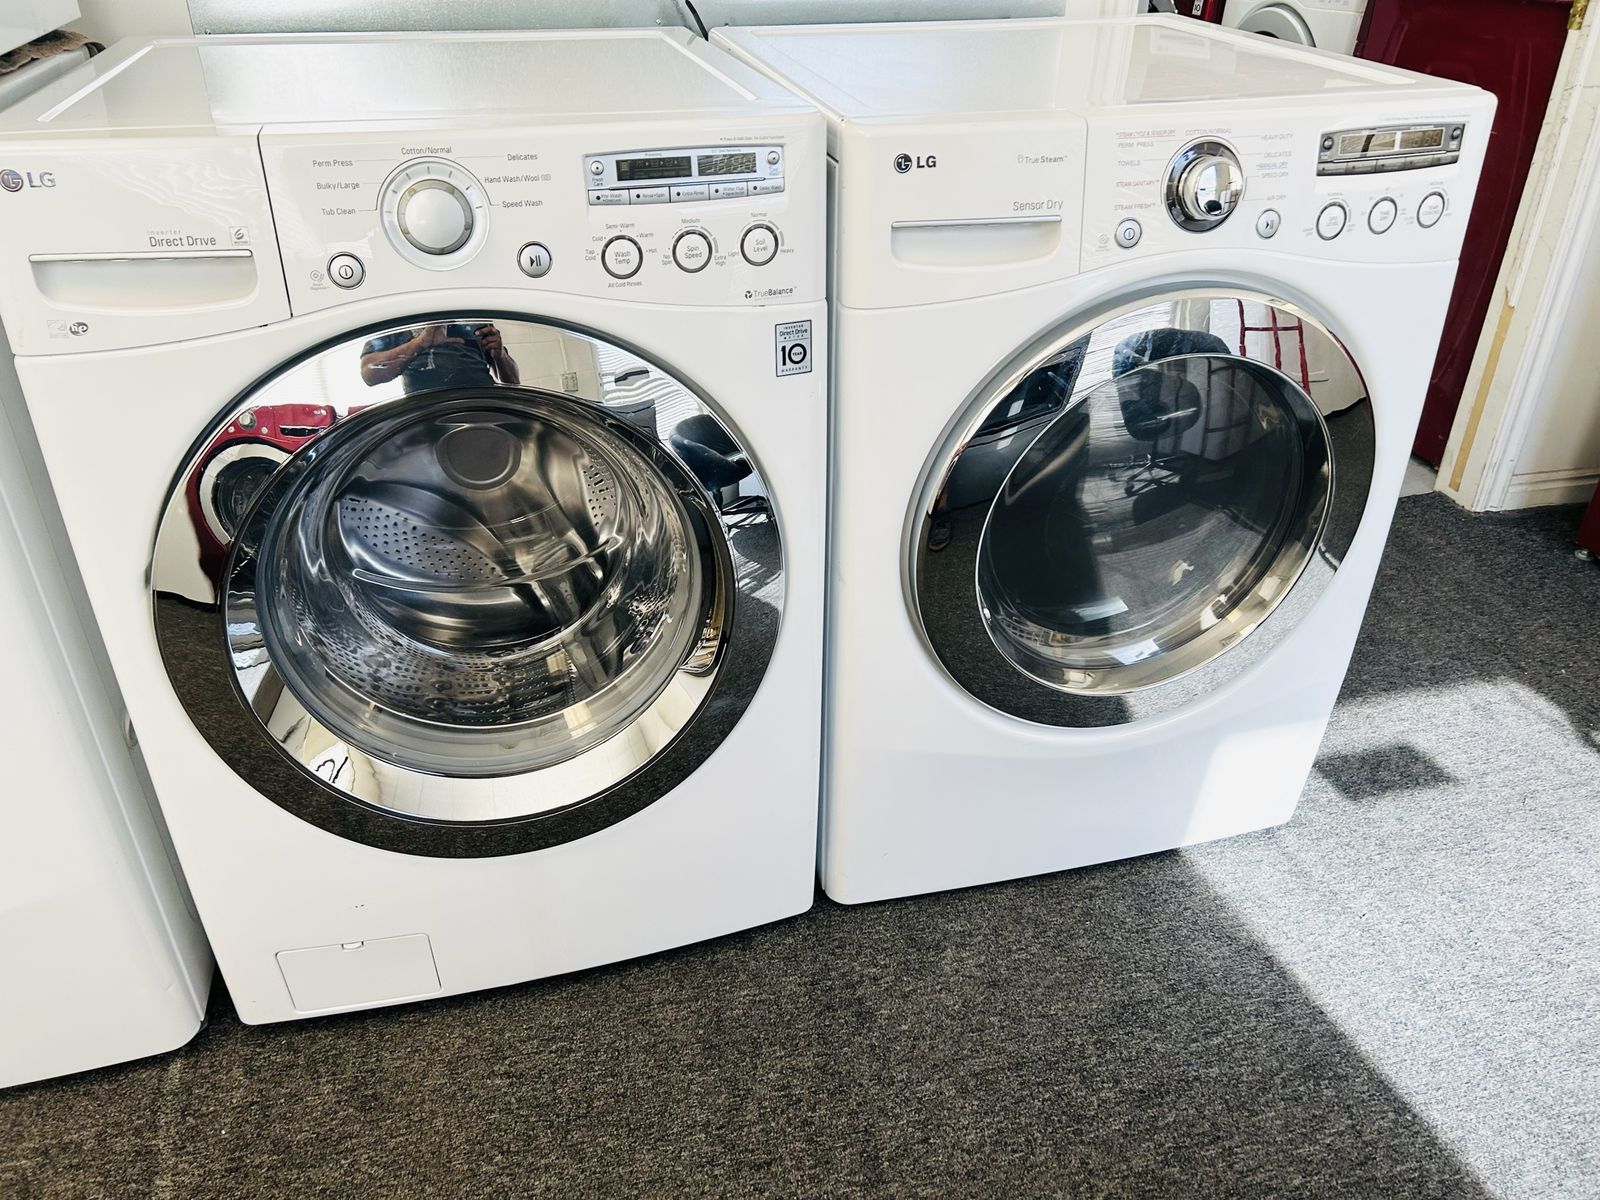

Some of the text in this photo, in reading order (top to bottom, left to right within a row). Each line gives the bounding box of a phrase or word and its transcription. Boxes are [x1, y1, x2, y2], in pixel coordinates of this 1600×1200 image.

[401, 146, 452, 155] Cotton/Normal
[507, 153, 538, 161] Delicates
[312, 159, 353, 168] Perm Press
[916, 156, 937, 168] LG
[26, 171, 57, 188] LG
[484, 174, 540, 184] Hand Wash/Wool
[316, 181, 360, 190] Bulky/Large
[502, 199, 543, 208] Speed Wash
[1012, 199, 1064, 212] Sensor Dry
[321, 207, 356, 216] Tub Clean
[149, 235, 216, 247] Direct Drive
[755, 238, 766, 246] Soil
[686, 245, 700, 253] Spin
[753, 245, 768, 253] Level
[614, 250, 631, 258] Wash
[684, 252, 702, 260] Speed
[781, 343, 807, 366] 10
